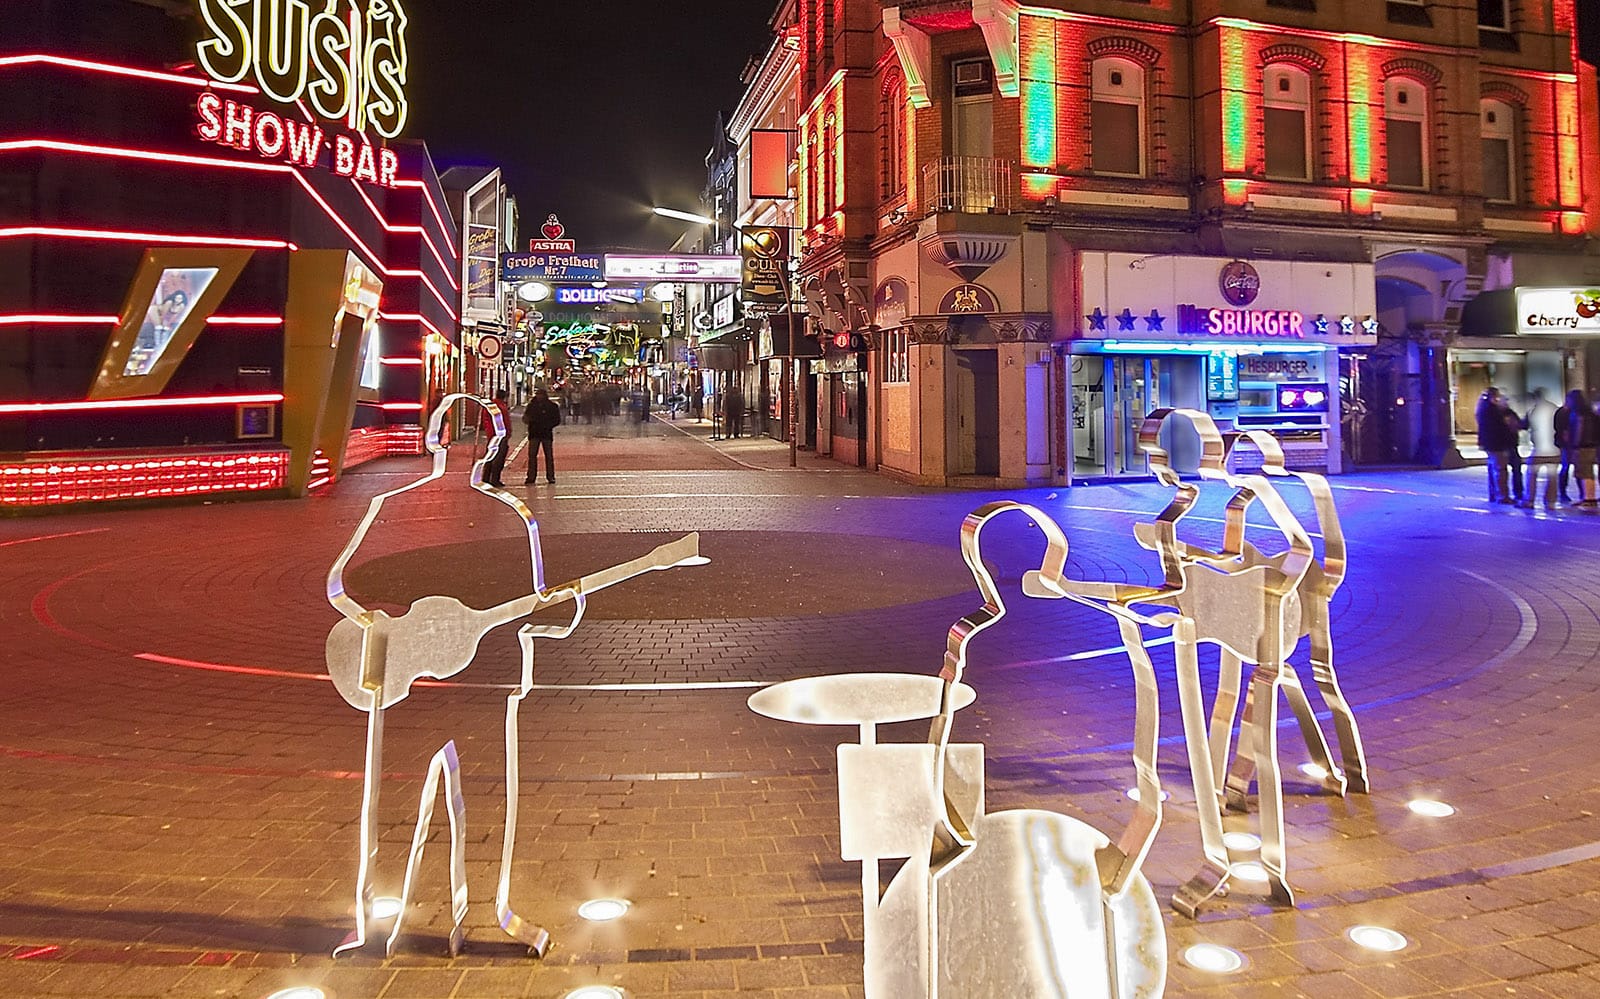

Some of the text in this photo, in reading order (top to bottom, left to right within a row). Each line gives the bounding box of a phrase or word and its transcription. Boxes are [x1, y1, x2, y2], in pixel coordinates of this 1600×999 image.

[196, 92, 399, 188] SHOW BAR
[533, 240, 572, 251] ASTRA
[506, 255, 599, 269] Große Freiheit
[1527, 313, 1579, 328] Cherry
[1248, 358, 1309, 374] HESBURGER
